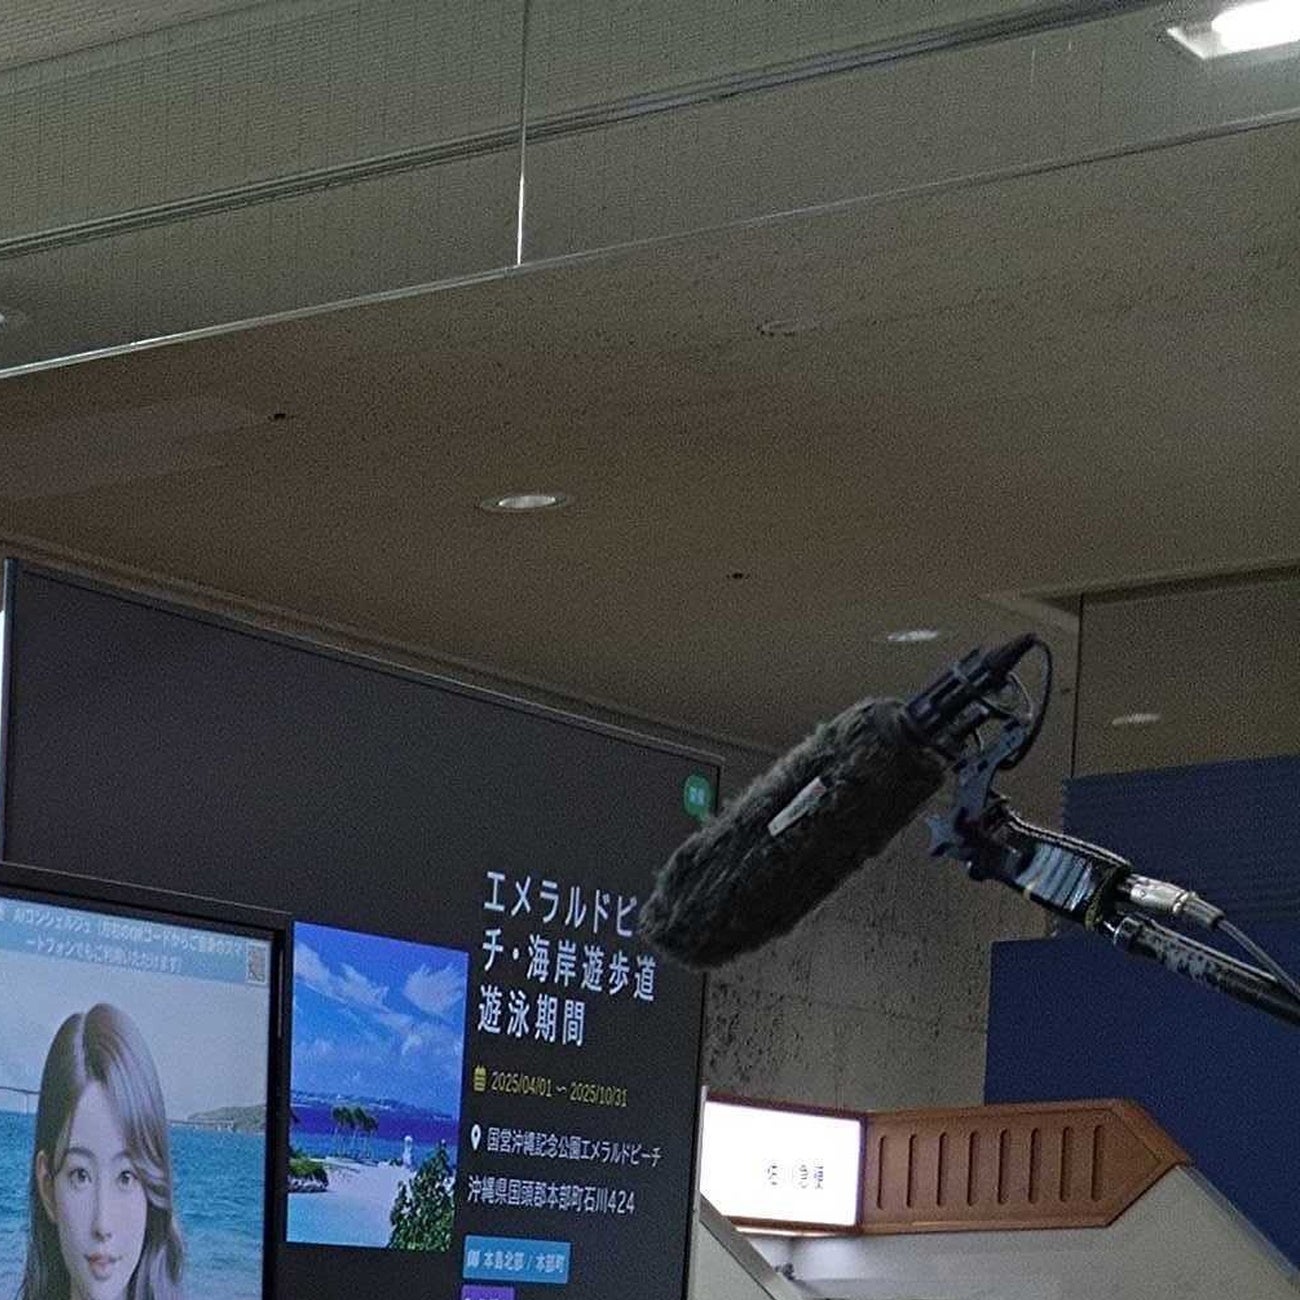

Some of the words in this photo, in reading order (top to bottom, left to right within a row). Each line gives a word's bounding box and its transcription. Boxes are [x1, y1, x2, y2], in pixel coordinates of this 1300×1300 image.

[483, 928, 657, 1001] チ・海岸遊歩道
[478, 984, 585, 1047] 遊泳期間
[491, 1070, 553, 1099] 2025/04/01
[570, 1080, 628, 1108] 2025/10/31
[467, 1175, 636, 1214] 沖縄県国頭郡本部町石川424
